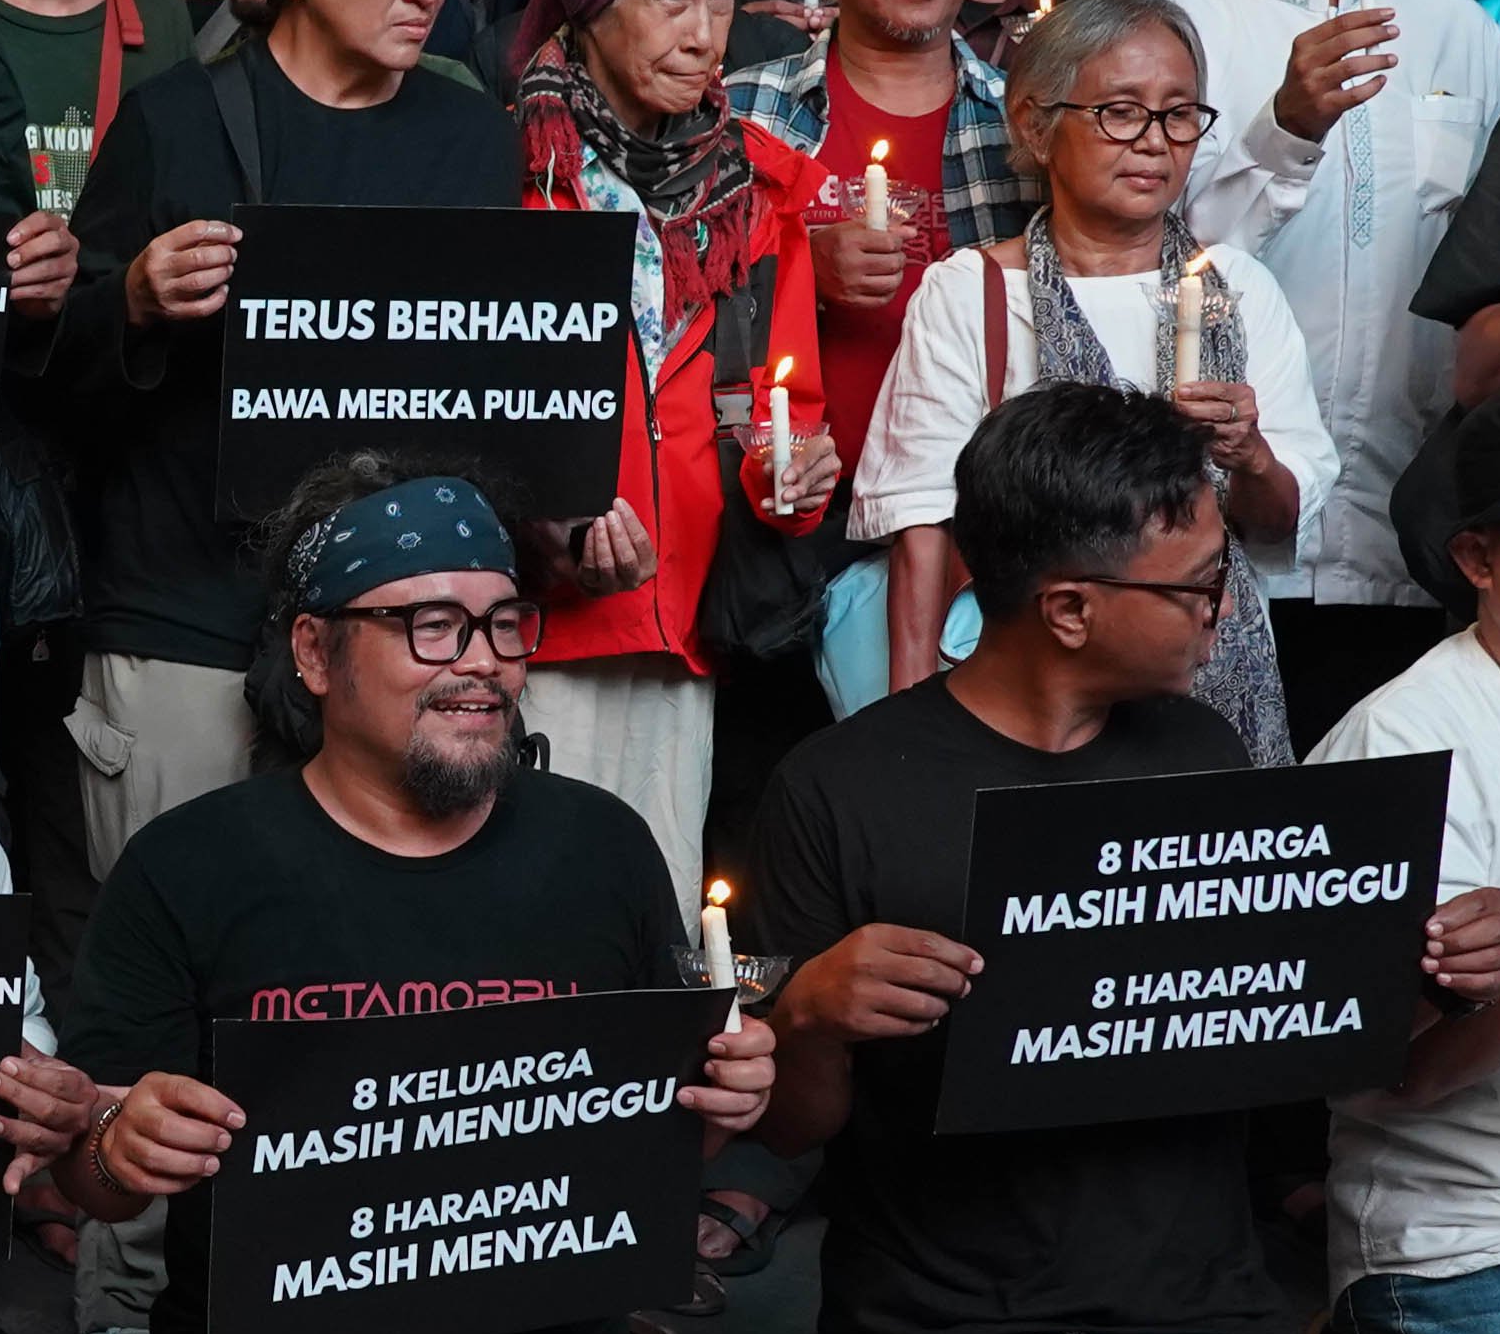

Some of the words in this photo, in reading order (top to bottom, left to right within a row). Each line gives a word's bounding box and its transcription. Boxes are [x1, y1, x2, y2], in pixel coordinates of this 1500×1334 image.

[239, 299, 376, 340] TERUS
[387, 300, 619, 342] BERHARAP
[232, 388, 331, 420] BAWA
[337, 389, 476, 421] MEREKA
[484, 390, 617, 421] PULANG
[1097, 841, 1123, 875] 8
[1131, 824, 1331, 873] KELUARGA
[1002, 885, 1145, 935] MASIH
[1155, 861, 1410, 921] MENUNGGU
[1092, 977, 1116, 1010] 8
[1125, 959, 1306, 1007] HARAPAN
[1009, 1017, 1154, 1065] MASIH
[1162, 997, 1363, 1050] MENYALA
[352, 1077, 378, 1110] 8
[388, 1048, 594, 1107] KELUARGA
[252, 1119, 403, 1173] MASIH
[414, 1077, 677, 1151] MENUNGGU
[349, 1207, 375, 1239] 8
[384, 1175, 570, 1234] HARAPAN
[272, 1245, 418, 1302] MASIH
[429, 1210, 638, 1277] MENYALA
